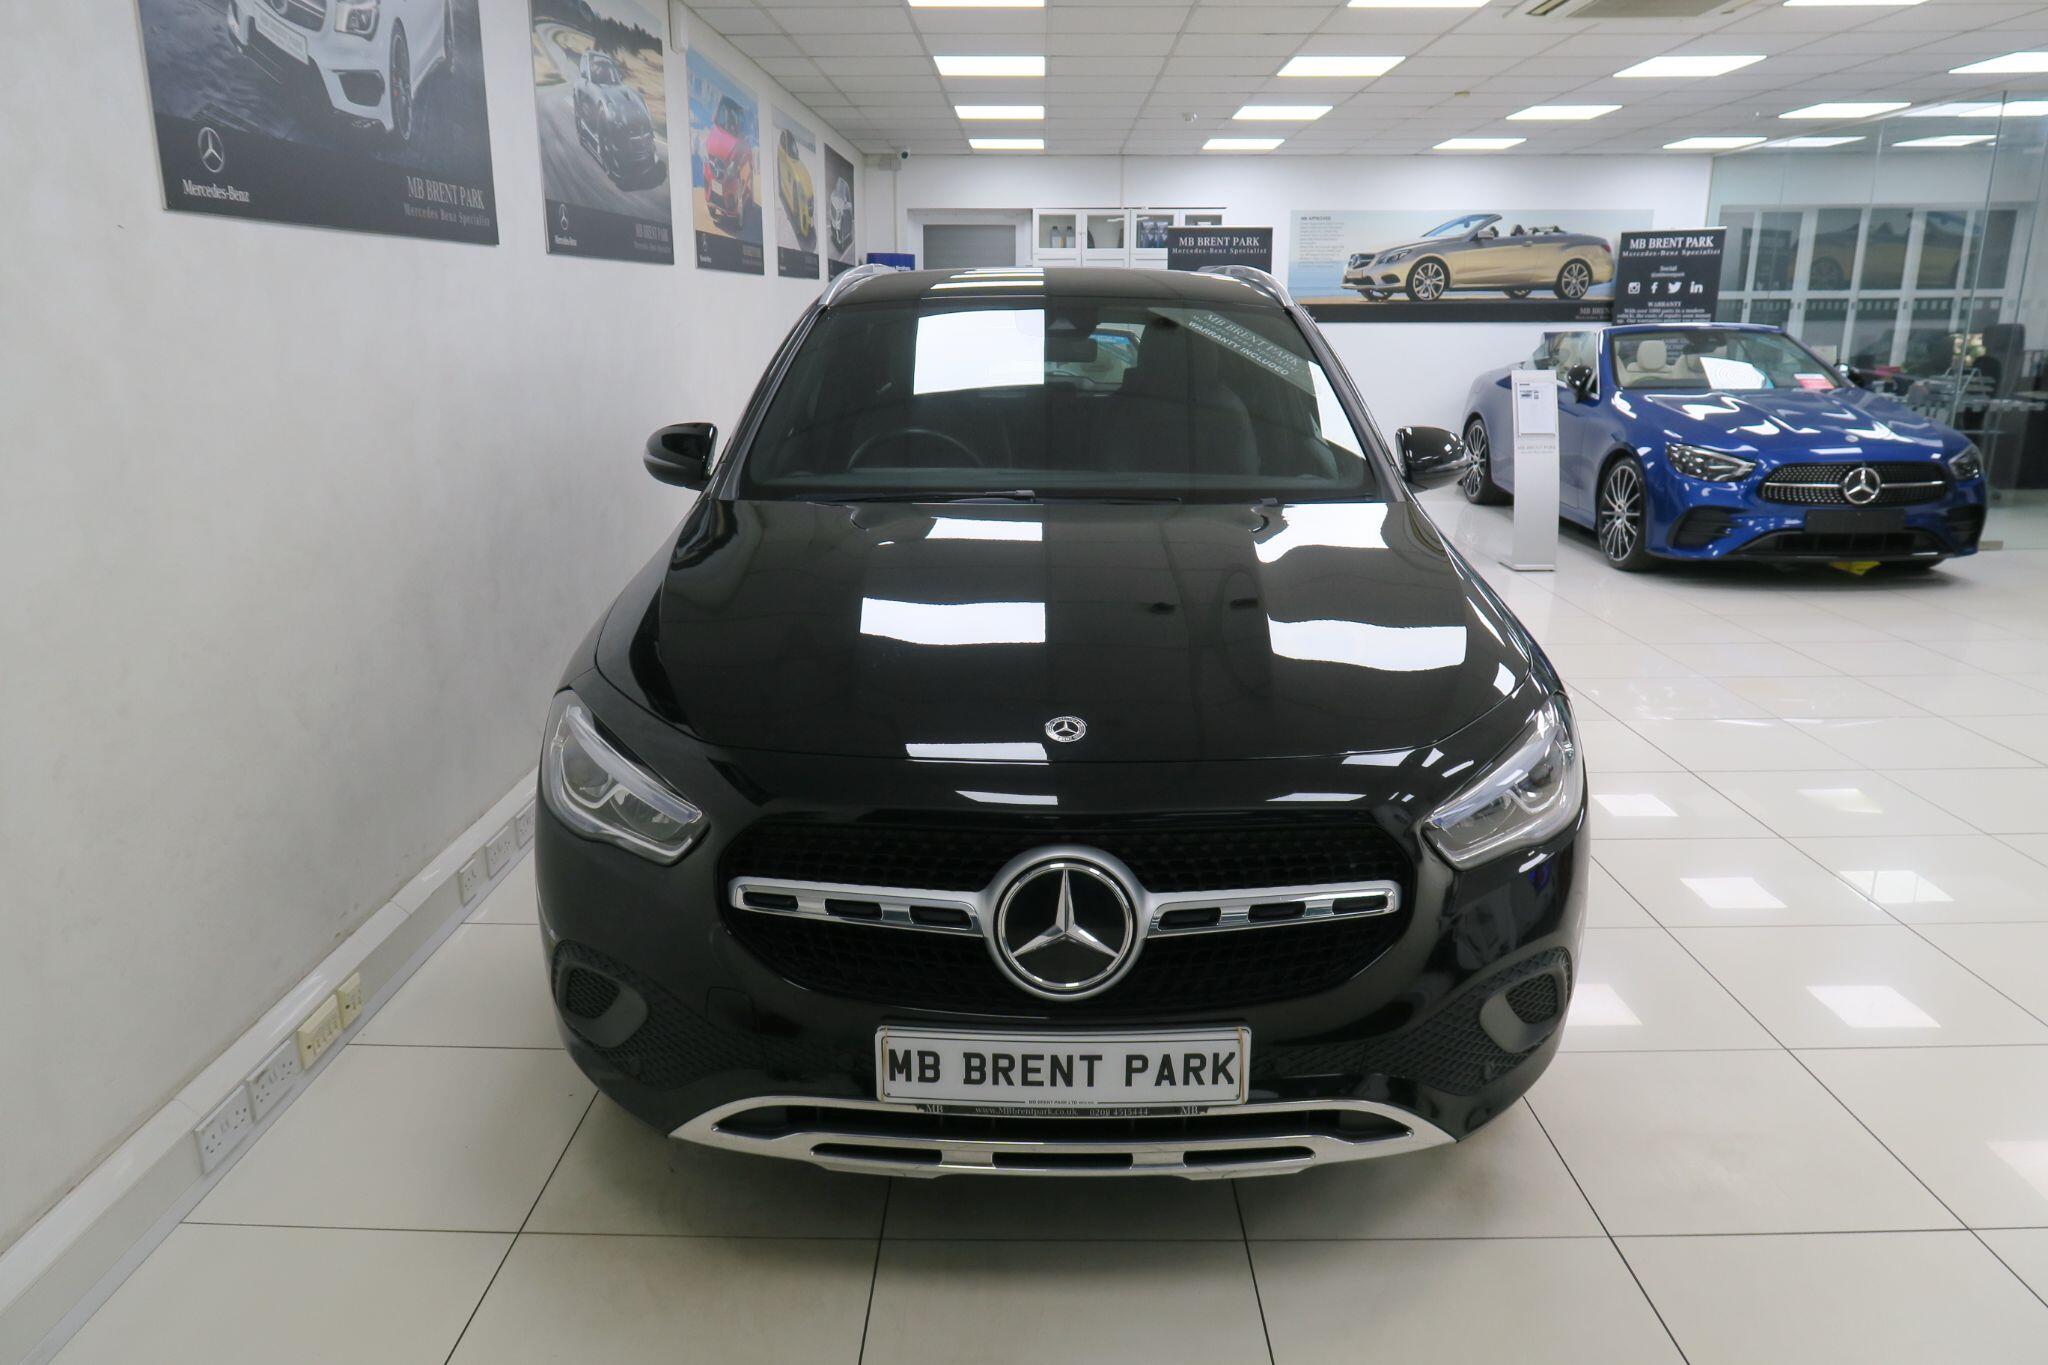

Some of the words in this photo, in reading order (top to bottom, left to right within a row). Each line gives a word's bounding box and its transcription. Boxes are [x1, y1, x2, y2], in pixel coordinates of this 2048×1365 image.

[182, 179, 249, 202] Mercedes-Benz
[406, 175, 425, 199] MB
[426, 179, 458, 205] BRENT
[460, 186, 485, 209] PARK
[1179, 236, 1194, 246] MB
[1197, 236, 1230, 246] BRENT
[1232, 236, 1259, 246] PARK
[1230, 247, 1267, 255] Specialist
[1629, 239, 1646, 249] MB
[1648, 237, 1683, 248] BRENT
[1685, 236, 1714, 247] PARK
[1206, 314, 1224, 326] MB
[1225, 323, 1267, 346] BRENT
[1188, 321, 1240, 349] WARRANTY
[1240, 346, 1289, 375] INCLUDED
[889, 1048, 941, 1083] MB
[963, 1052, 1103, 1087] BRENT
[1125, 1052, 1236, 1087] PARK
[927, 1103, 944, 1113] MB
[1181, 1105, 1200, 1115] MB
